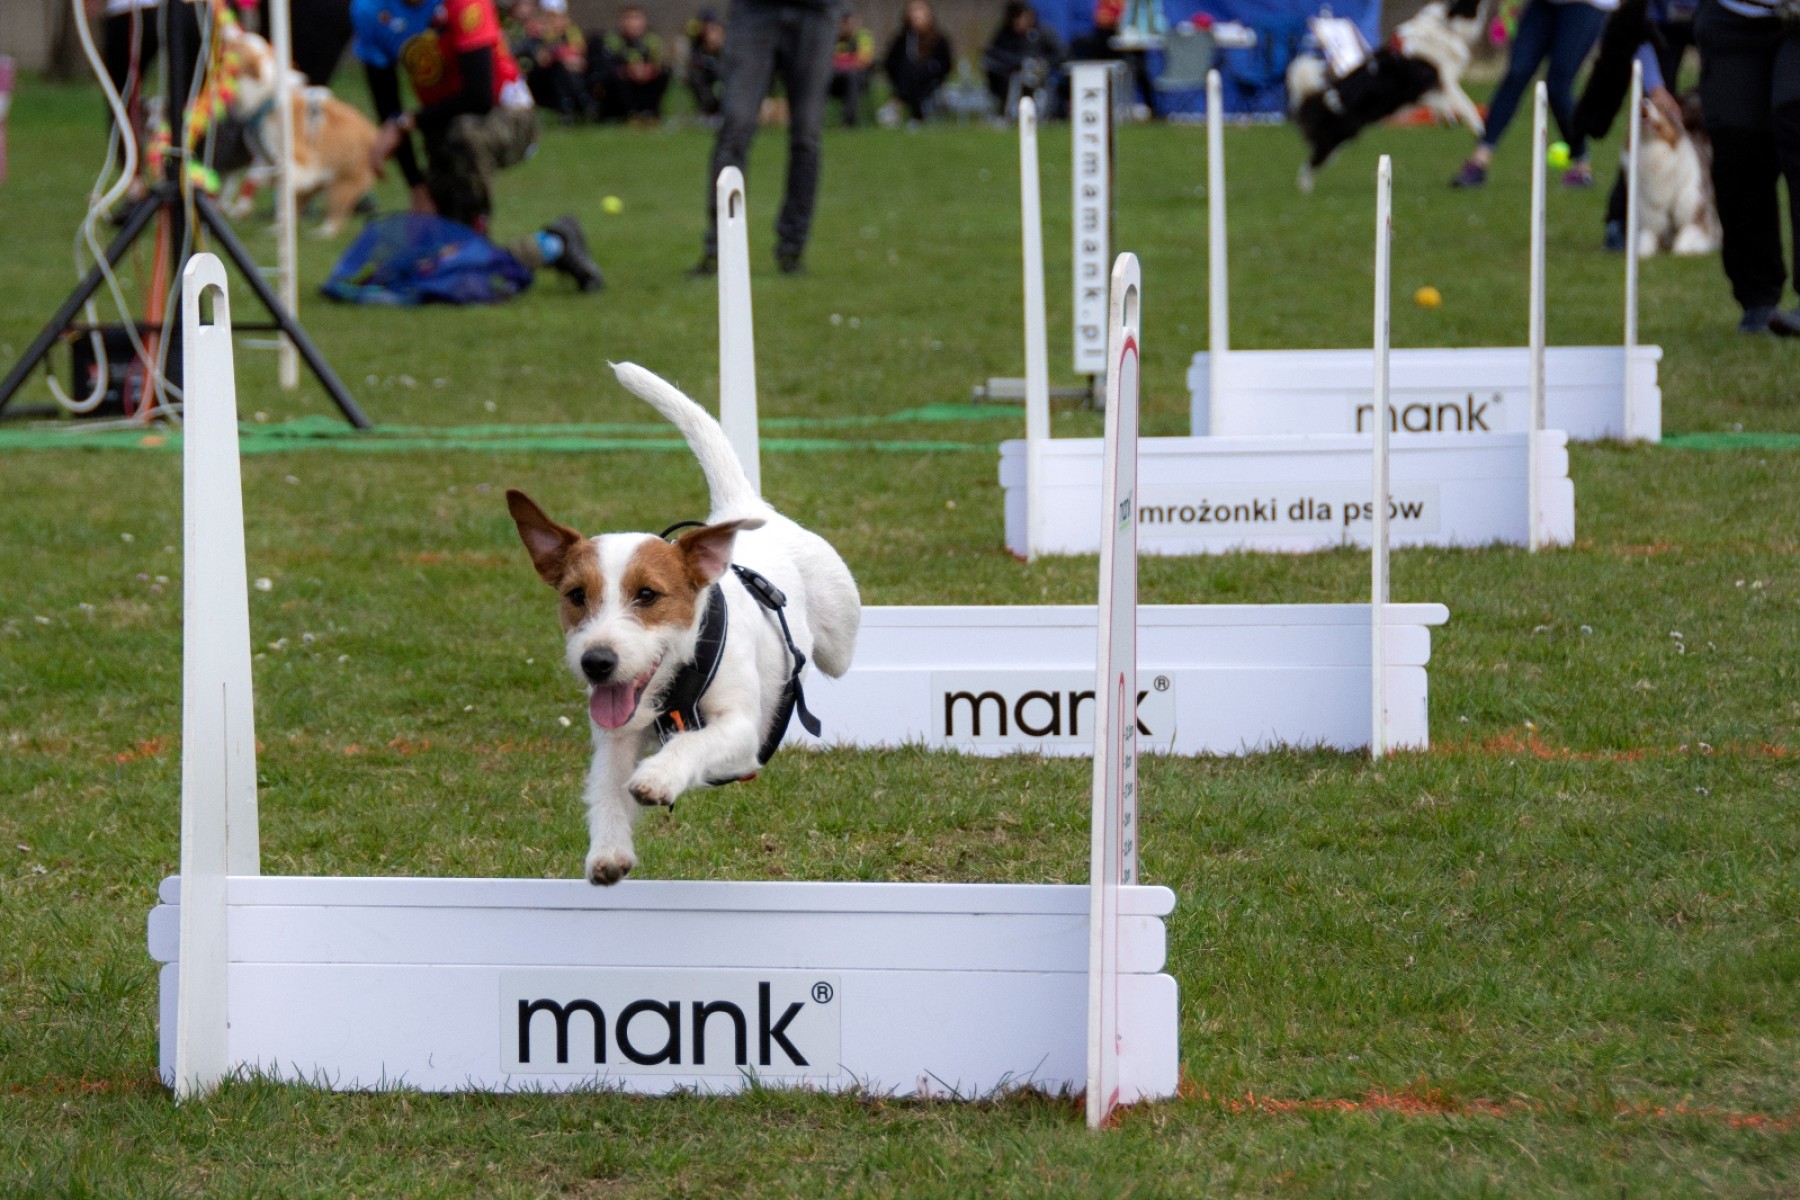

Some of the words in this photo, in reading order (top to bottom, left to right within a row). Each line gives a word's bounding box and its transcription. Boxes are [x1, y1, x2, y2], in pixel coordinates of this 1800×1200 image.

[1080, 87, 1105, 355] karmamank.pl
[1138, 498, 1277, 523] mrożonki
[1288, 498, 1332, 521] dla
